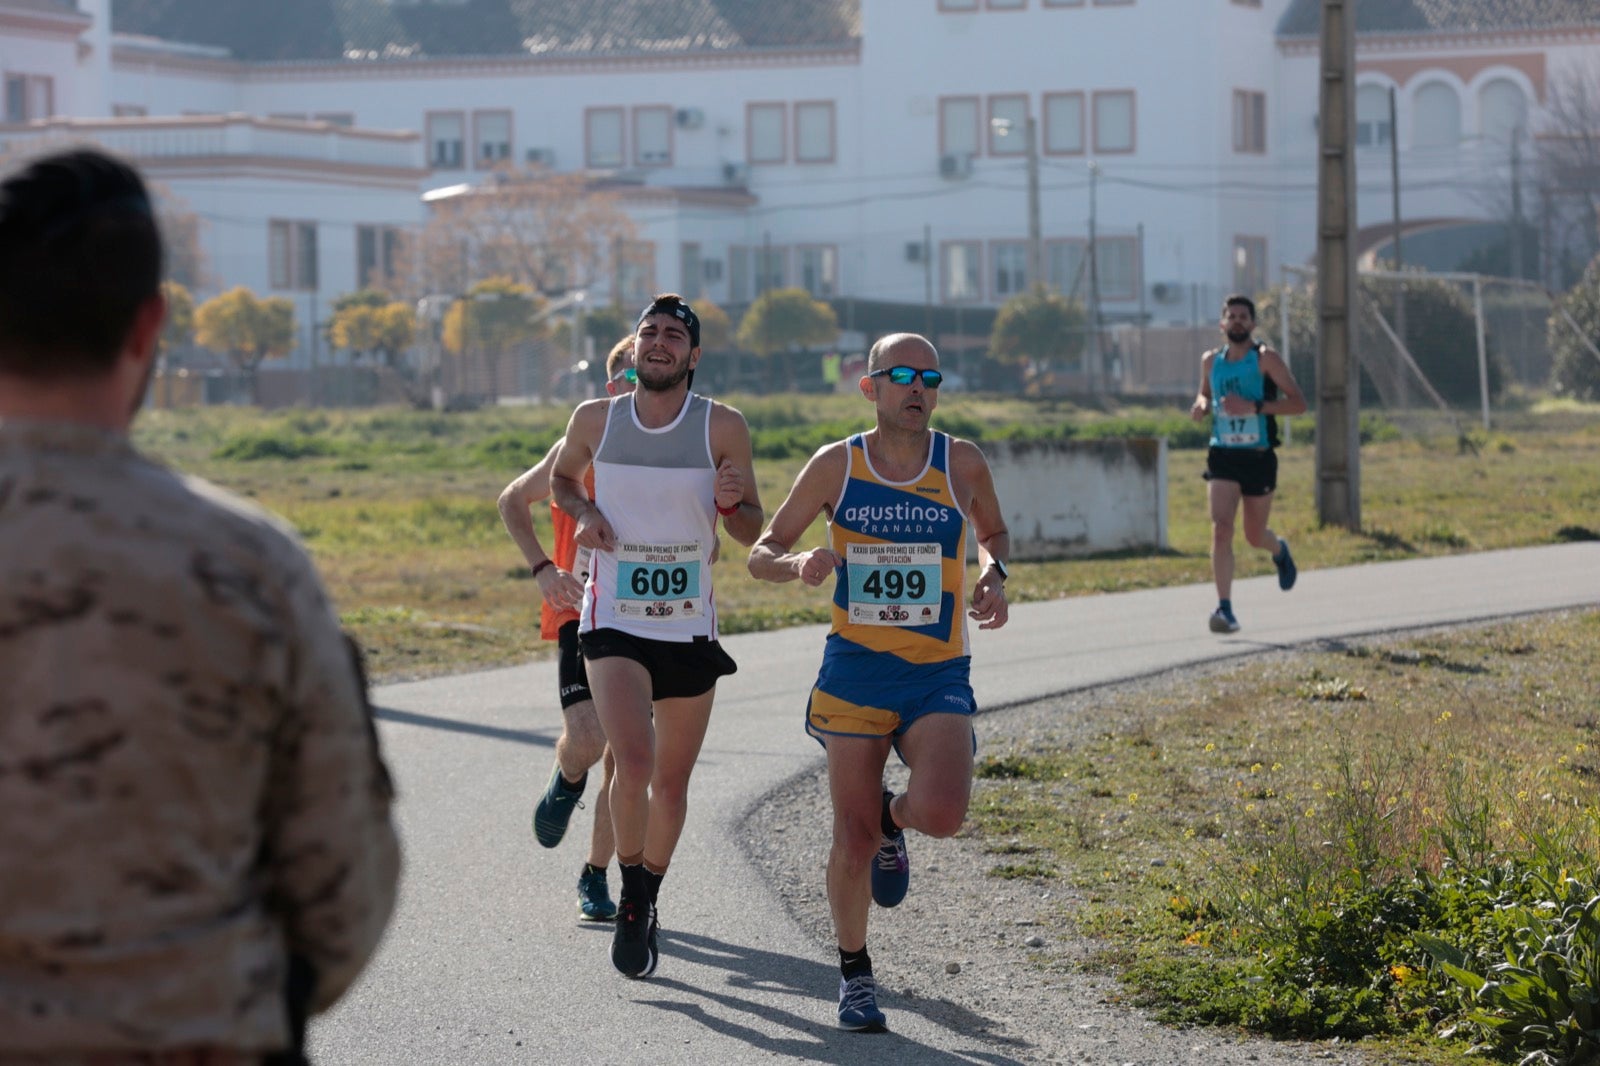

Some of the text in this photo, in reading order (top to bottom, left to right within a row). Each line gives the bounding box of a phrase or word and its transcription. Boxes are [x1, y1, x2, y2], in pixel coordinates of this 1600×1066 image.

[1229, 418, 1246, 432] 17
[845, 502, 949, 526] agustinos
[861, 525, 933, 533] GRANADA
[639, 545, 652, 553] GRAN
[654, 545, 672, 553] PREMIO
[674, 545, 679, 553] DE
[681, 545, 697, 553] FONDO
[631, 567, 688, 596] 609
[862, 569, 926, 599] 499
